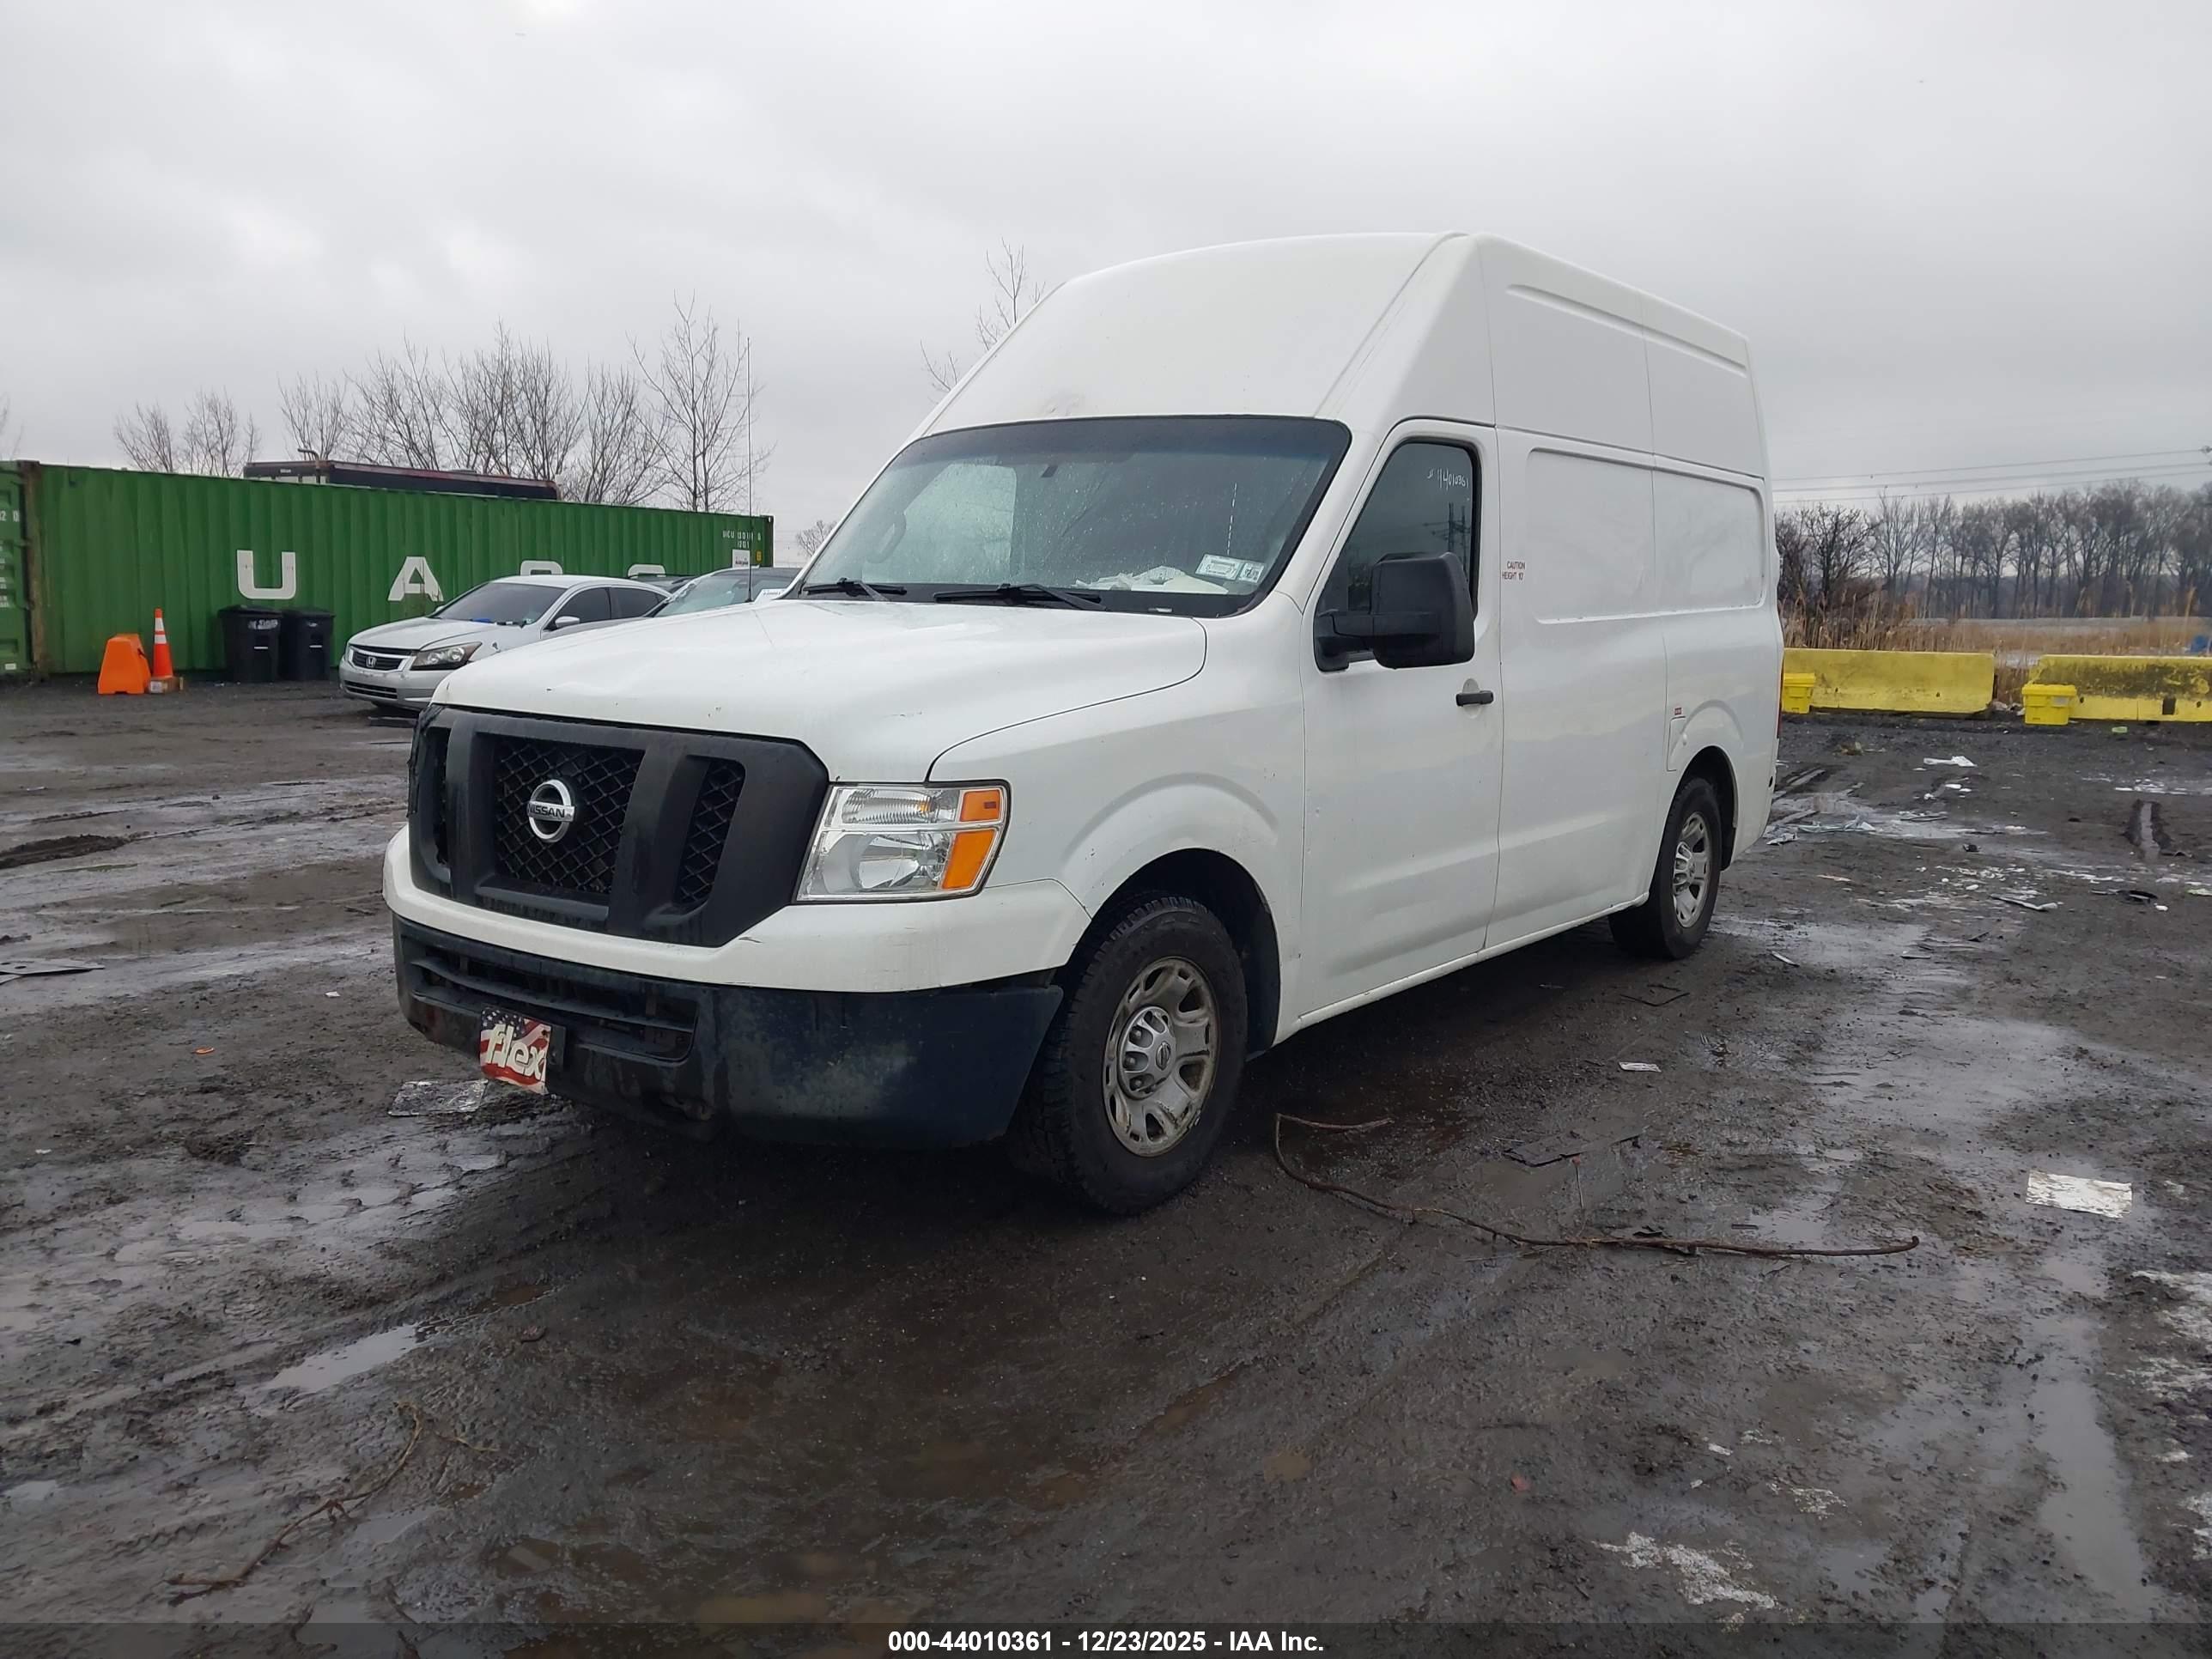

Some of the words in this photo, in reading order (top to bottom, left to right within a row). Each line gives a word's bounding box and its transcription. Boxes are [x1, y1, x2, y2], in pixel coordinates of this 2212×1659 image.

[1506, 561, 1525, 570] CAUTION
[1502, 571, 1516, 580] HEIGHT
[528, 803, 565, 818] NISSAN
